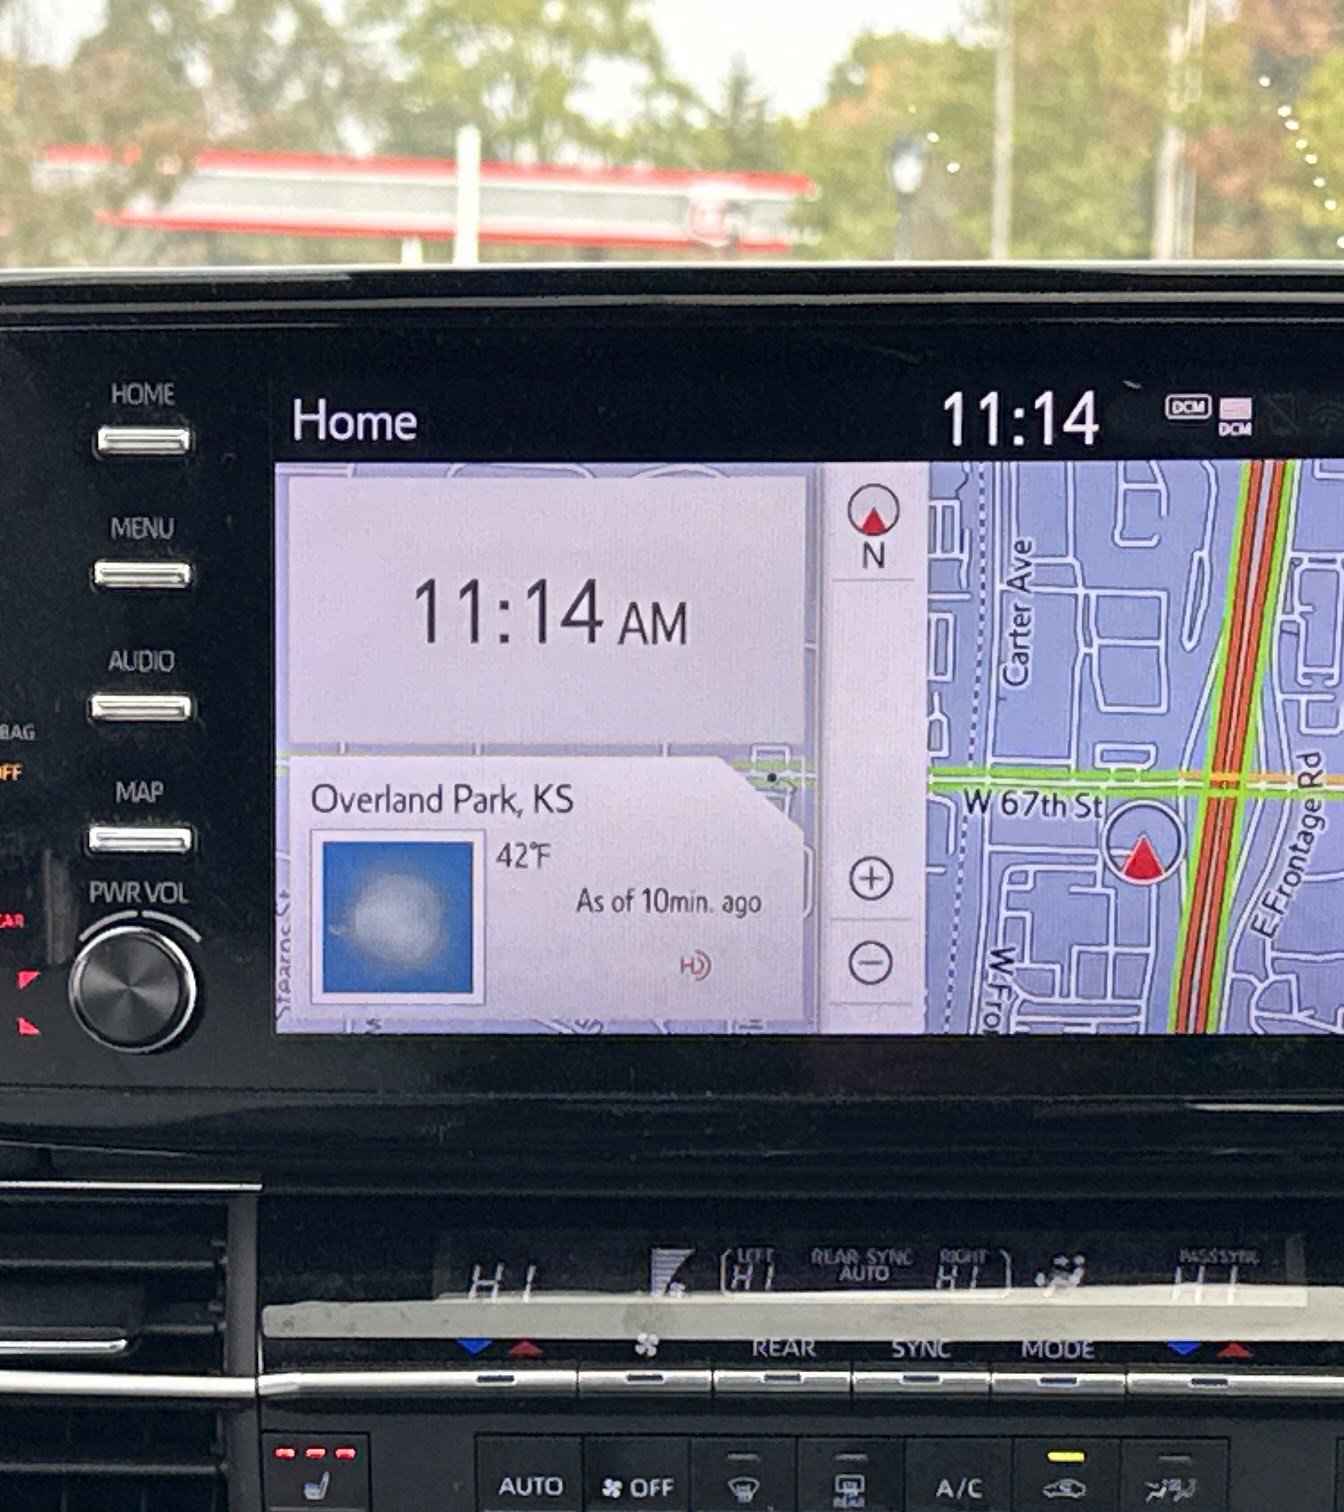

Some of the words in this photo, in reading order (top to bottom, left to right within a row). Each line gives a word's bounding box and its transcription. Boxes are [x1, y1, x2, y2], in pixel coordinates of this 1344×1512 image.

[111, 382, 176, 405] HOME
[292, 397, 418, 442] Home
[943, 390, 1100, 447] 11:14
[1170, 400, 1206, 416] DCM
[1218, 421, 1253, 437] DCM
[111, 516, 175, 540] MENU
[862, 544, 885, 568] N
[1006, 540, 1032, 593] Ave
[415, 578, 604, 645] 11:14
[617, 602, 688, 645] AM
[1002, 603, 1031, 686] Carter
[108, 649, 176, 673] AUDIO
[0, 723, 36, 742] BAG
[117, 780, 164, 804] MAP
[311, 783, 443, 814] Overland
[454, 783, 523, 818] Park,
[533, 783, 574, 814] KS
[964, 789, 992, 815] W
[1001, 790, 1068, 819] 67th
[1074, 793, 1103, 819] St
[496, 842, 552, 869] 42°F
[1251, 916, 1277, 939] E
[1264, 799, 1326, 915] Frontage
[1297, 751, 1325, 789] Rd
[89, 880, 142, 904] PWR
[144, 880, 190, 904] VOL
[576, 888, 604, 914] As
[611, 887, 635, 914] of
[642, 887, 715, 914] 10min.
[721, 893, 763, 919] ago
[989, 946, 1016, 976] W
[812, 1248, 859, 1265] REAR
[867, 1248, 913, 1266] SYNC
[839, 1265, 891, 1282] AUTO
[752, 1340, 815, 1358] REAR
[892, 1340, 951, 1359] SYNC
[1022, 1340, 1095, 1359] MODE
[499, 1477, 564, 1498] AUTO
[630, 1478, 675, 1499] OFF
[936, 1478, 983, 1499] A/C
